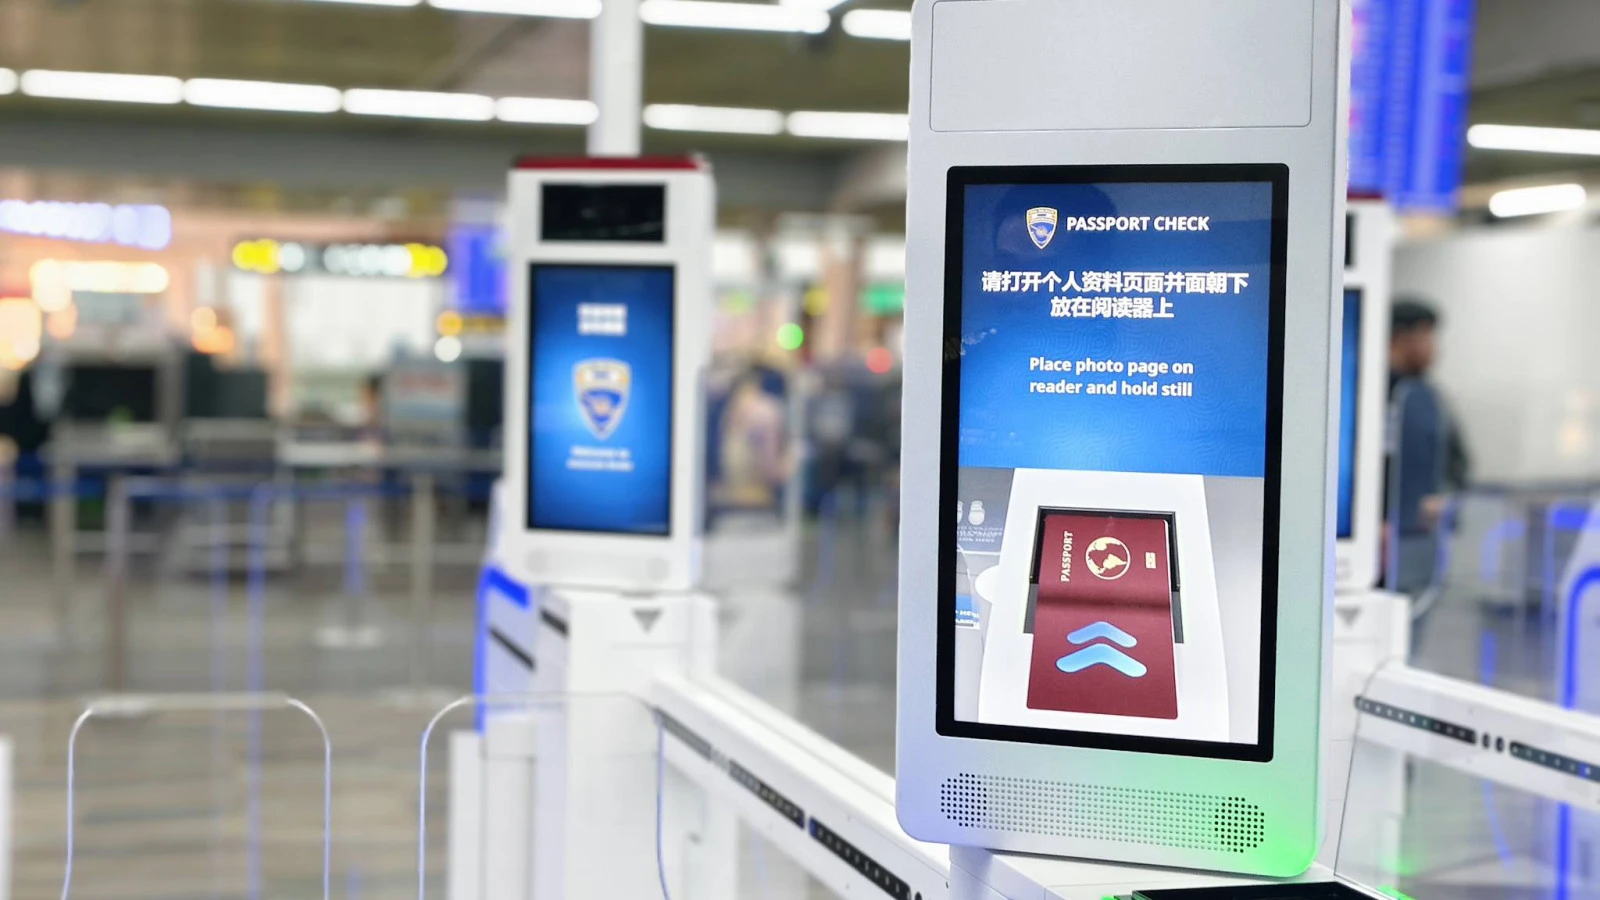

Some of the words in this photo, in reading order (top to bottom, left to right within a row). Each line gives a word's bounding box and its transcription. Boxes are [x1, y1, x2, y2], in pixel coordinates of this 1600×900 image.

[1066, 216, 1150, 231] PASSPORT
[1153, 216, 1210, 231] CHECK
[981, 270, 1249, 294] 请打开个人资料页面并面朝下
[1050, 296, 1174, 319] 放在阅读器上
[1029, 356, 1072, 372] Place
[1075, 357, 1124, 376] photo
[1127, 361, 1169, 378] page
[1171, 362, 1194, 374] on
[1029, 379, 1083, 394] reader
[1086, 380, 1117, 395] and
[1121, 380, 1158, 396] hold
[1161, 381, 1193, 397] still
[1060, 530, 1074, 582] PASSPORT
